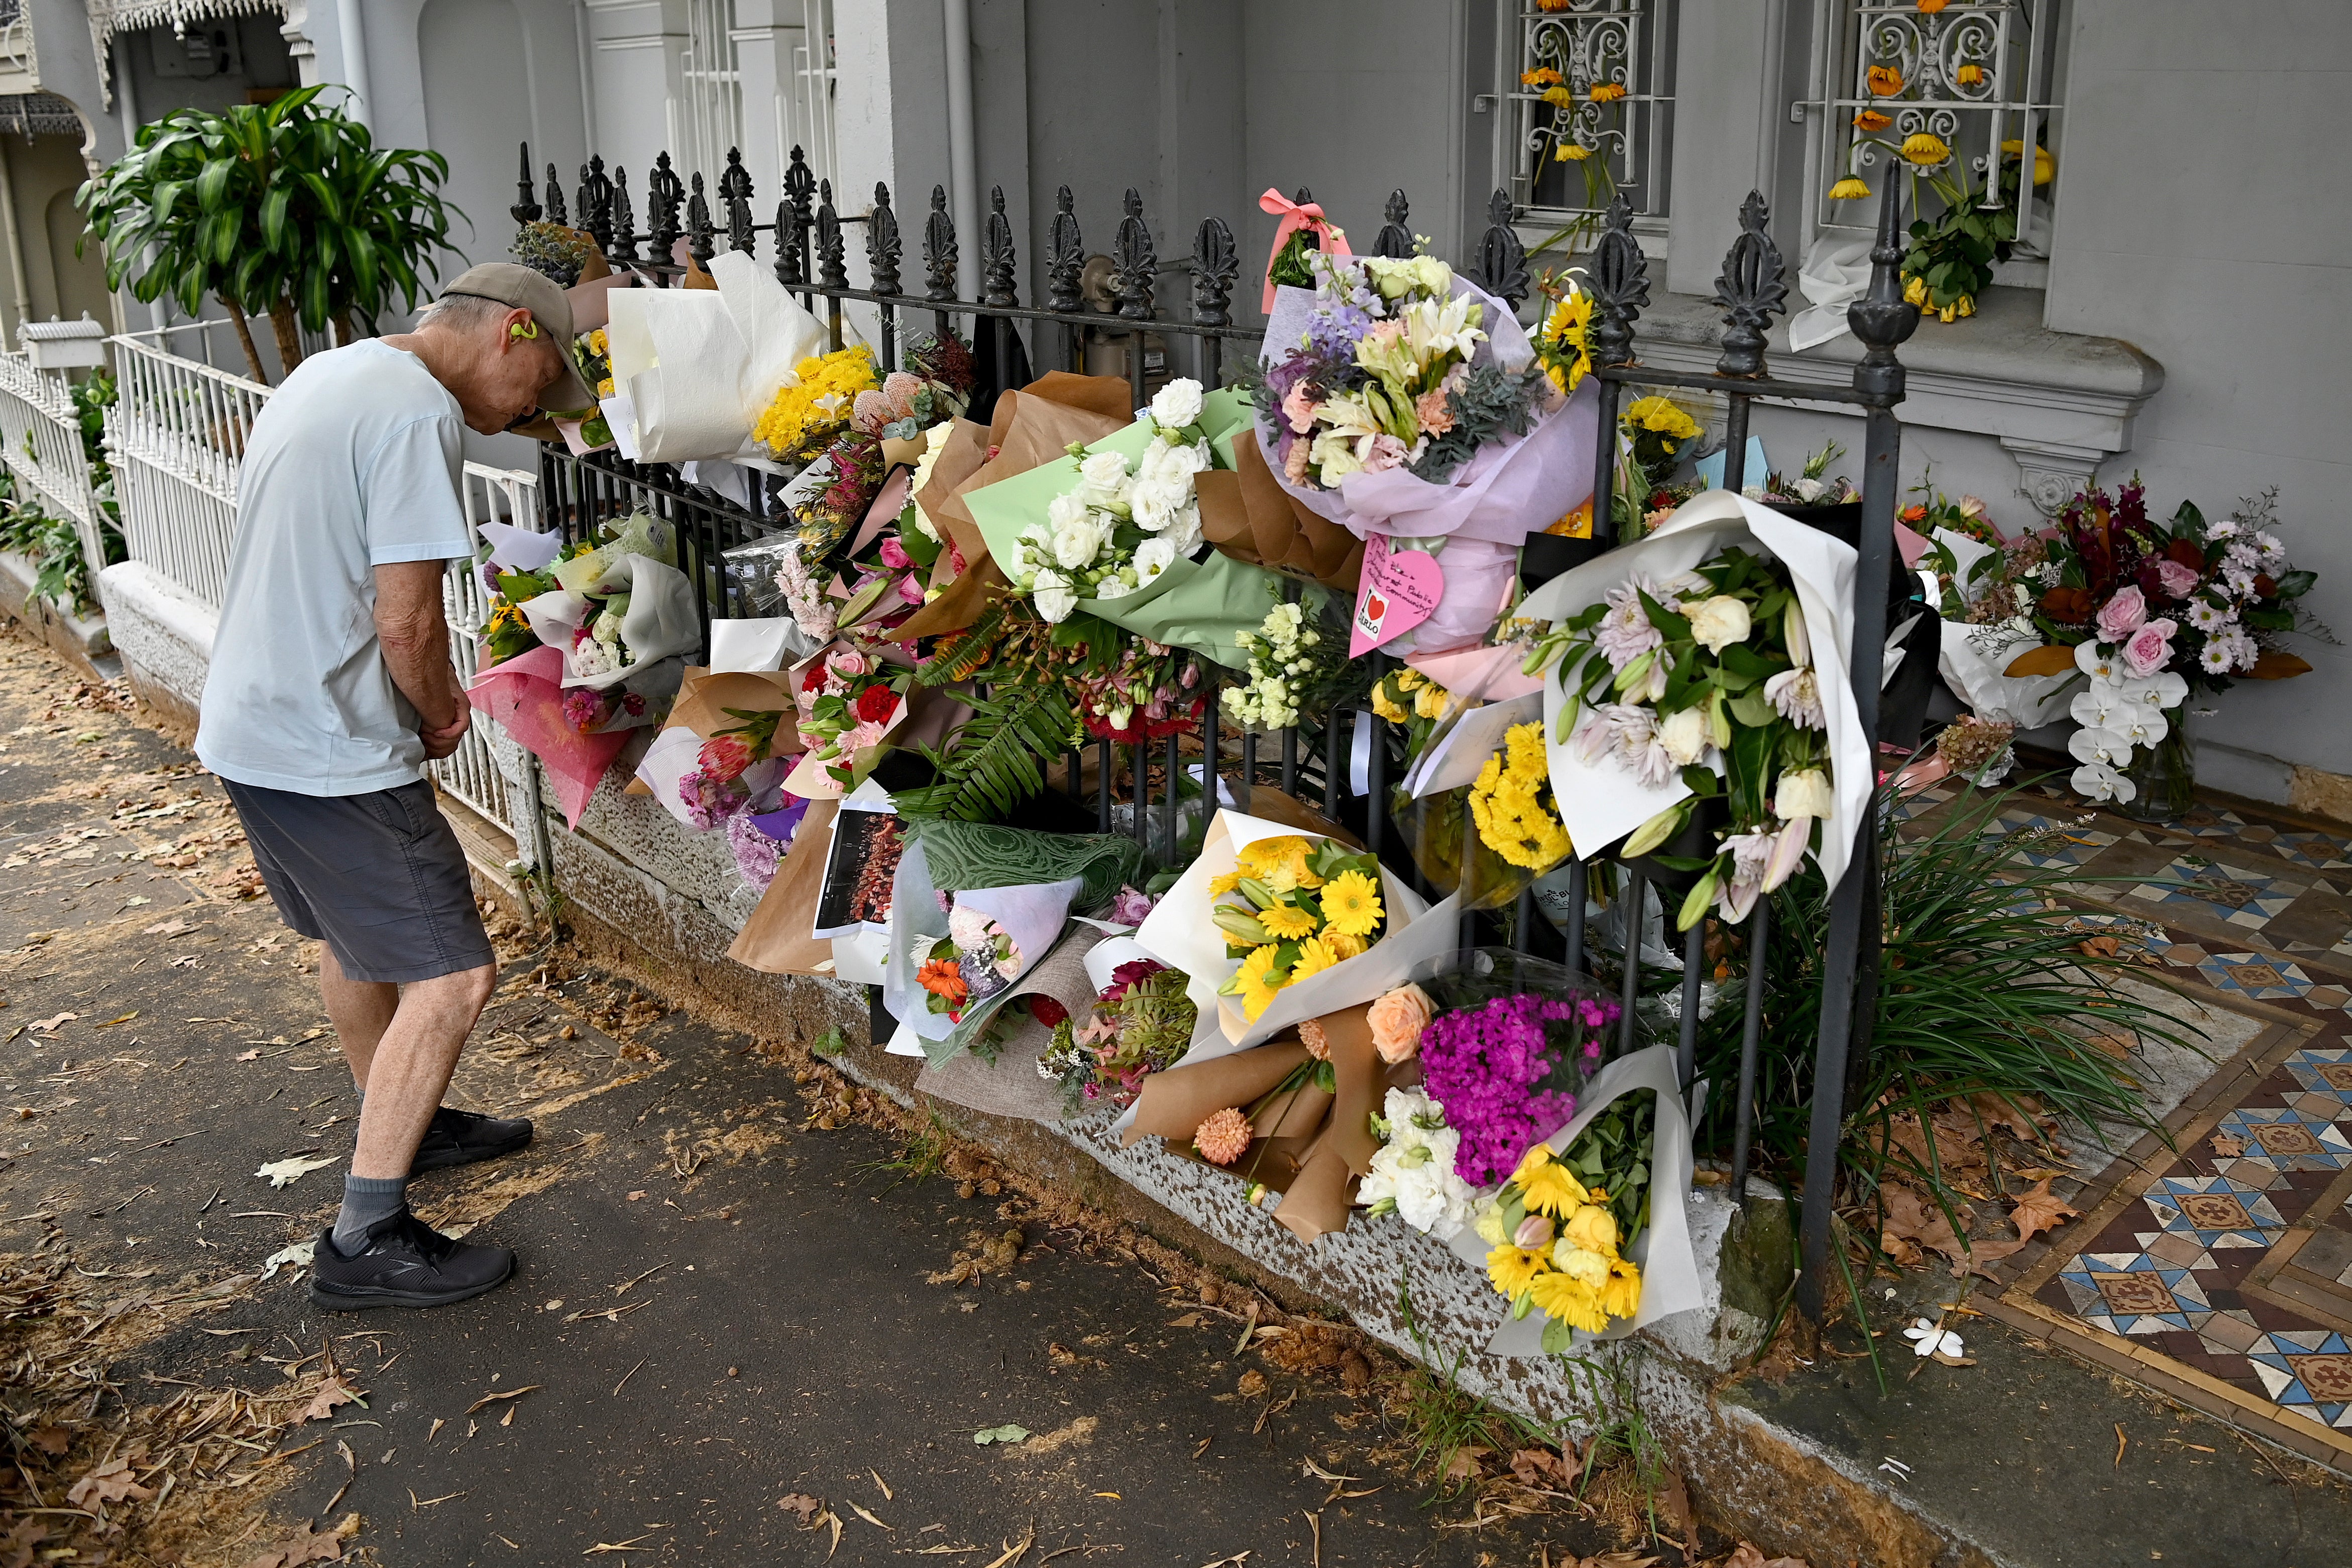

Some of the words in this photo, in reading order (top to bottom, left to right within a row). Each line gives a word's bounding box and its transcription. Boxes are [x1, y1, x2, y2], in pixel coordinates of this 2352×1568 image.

[1362, 589, 1372, 613] I
[1407, 585, 1432, 604] Public
[1358, 612, 1378, 634] DARLO
